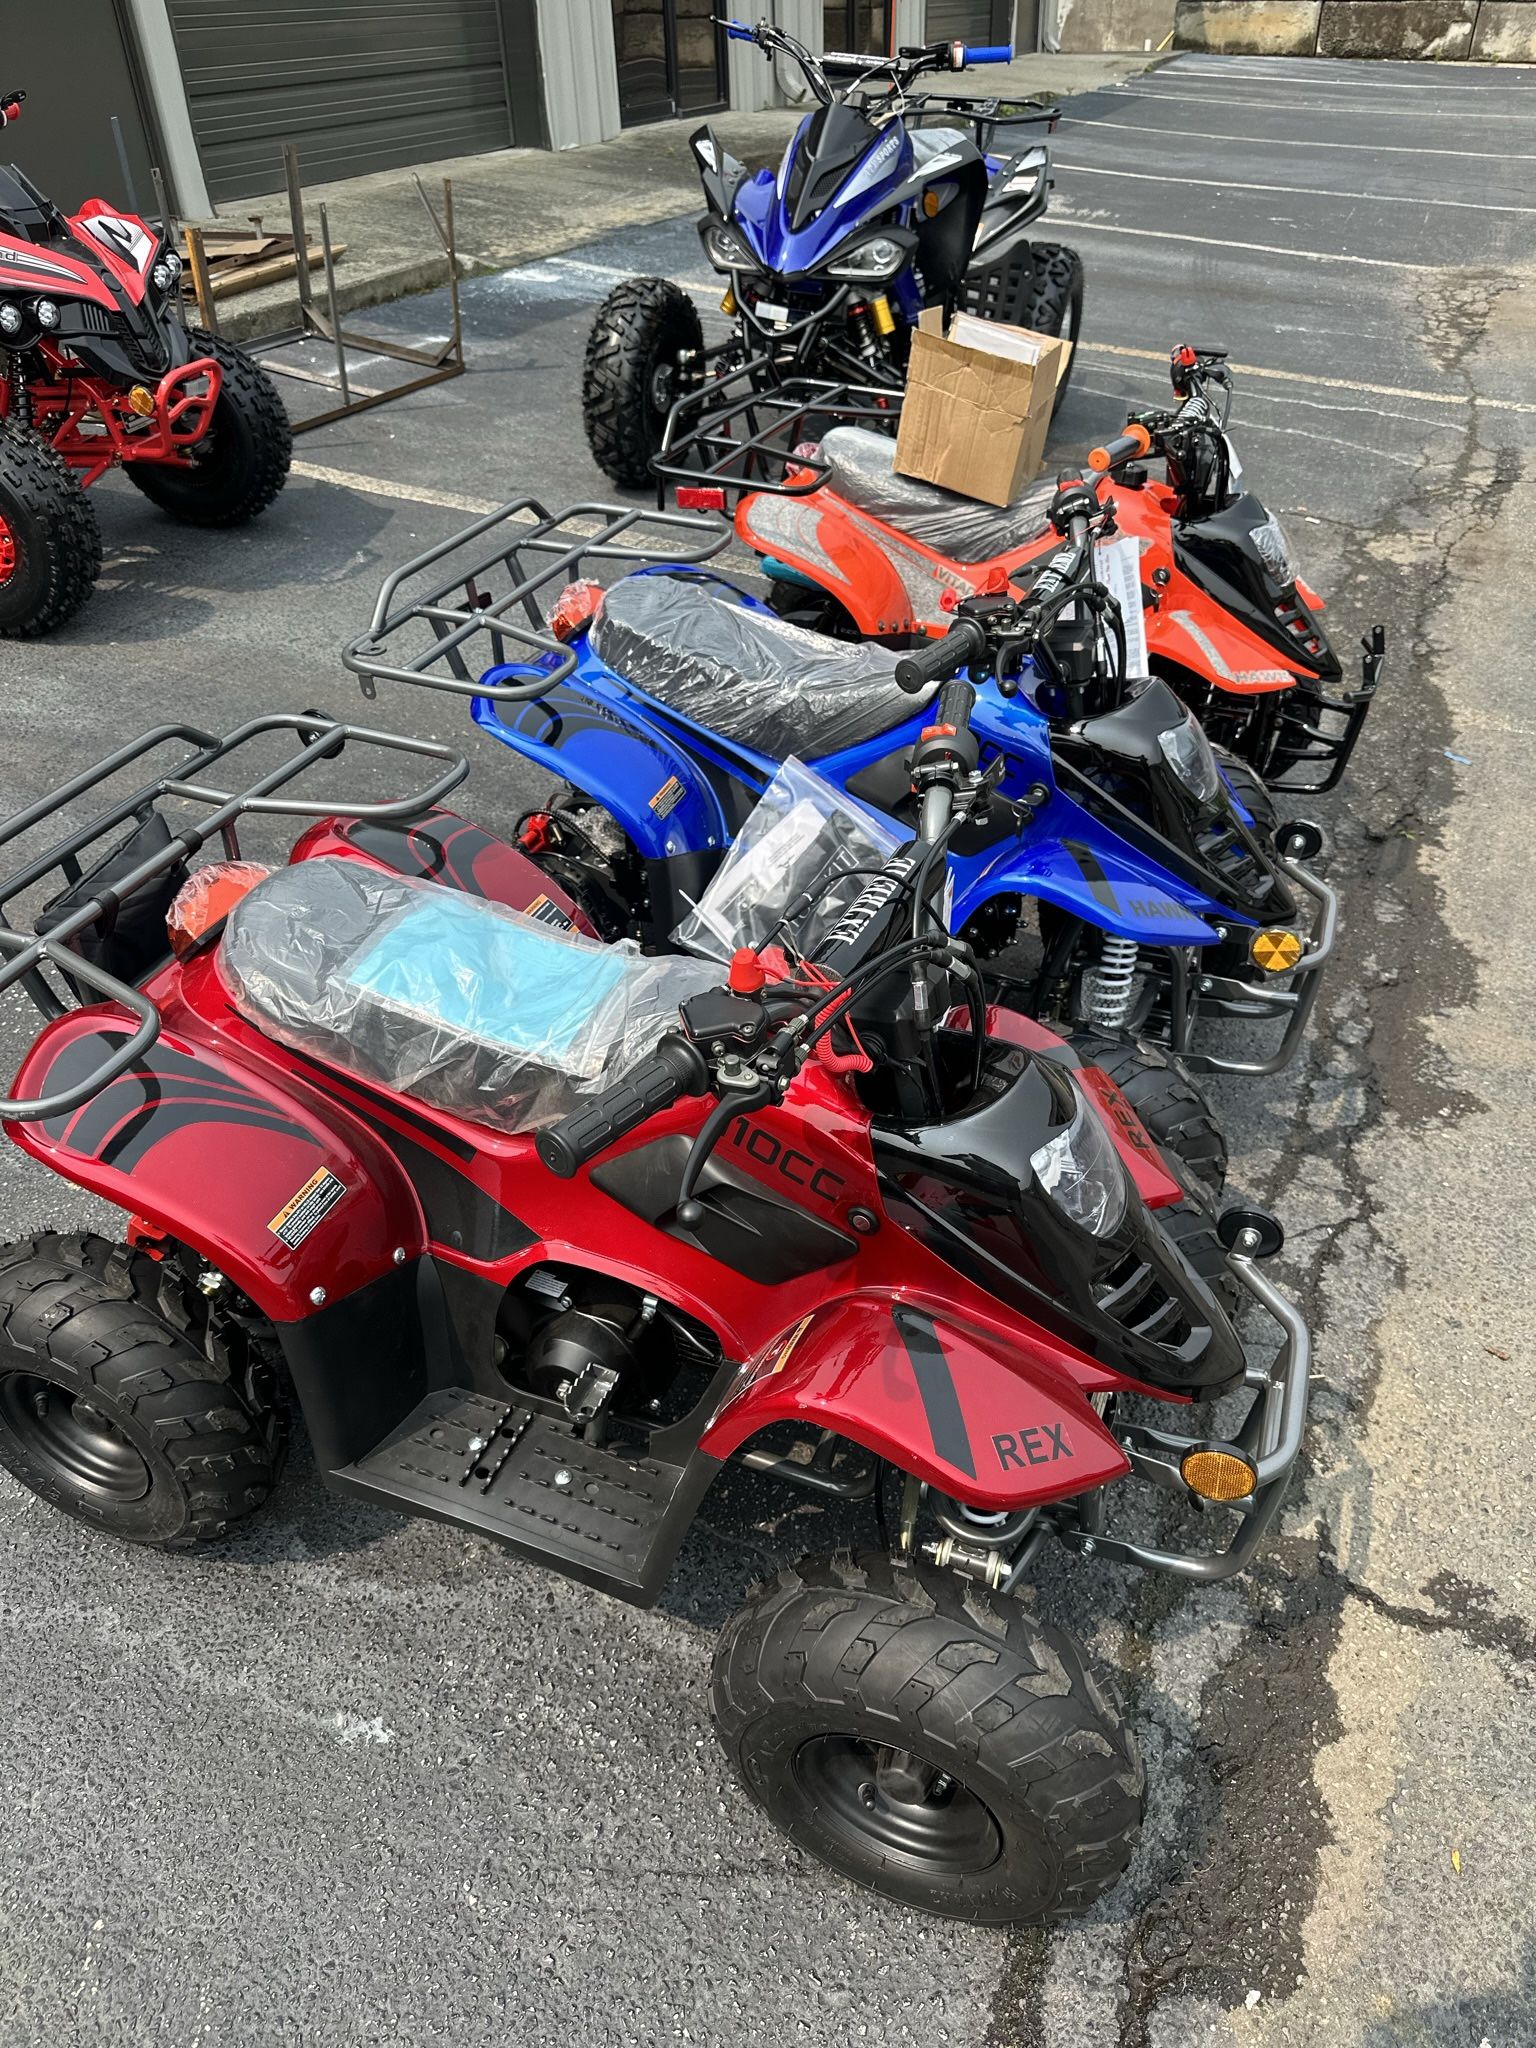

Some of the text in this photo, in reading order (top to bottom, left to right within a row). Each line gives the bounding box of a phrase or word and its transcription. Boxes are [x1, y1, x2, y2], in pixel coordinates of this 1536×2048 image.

[1100, 1088, 1152, 1149] REX
[288, 1179, 318, 1210] WARNING
[991, 1423, 1074, 1471] REX
